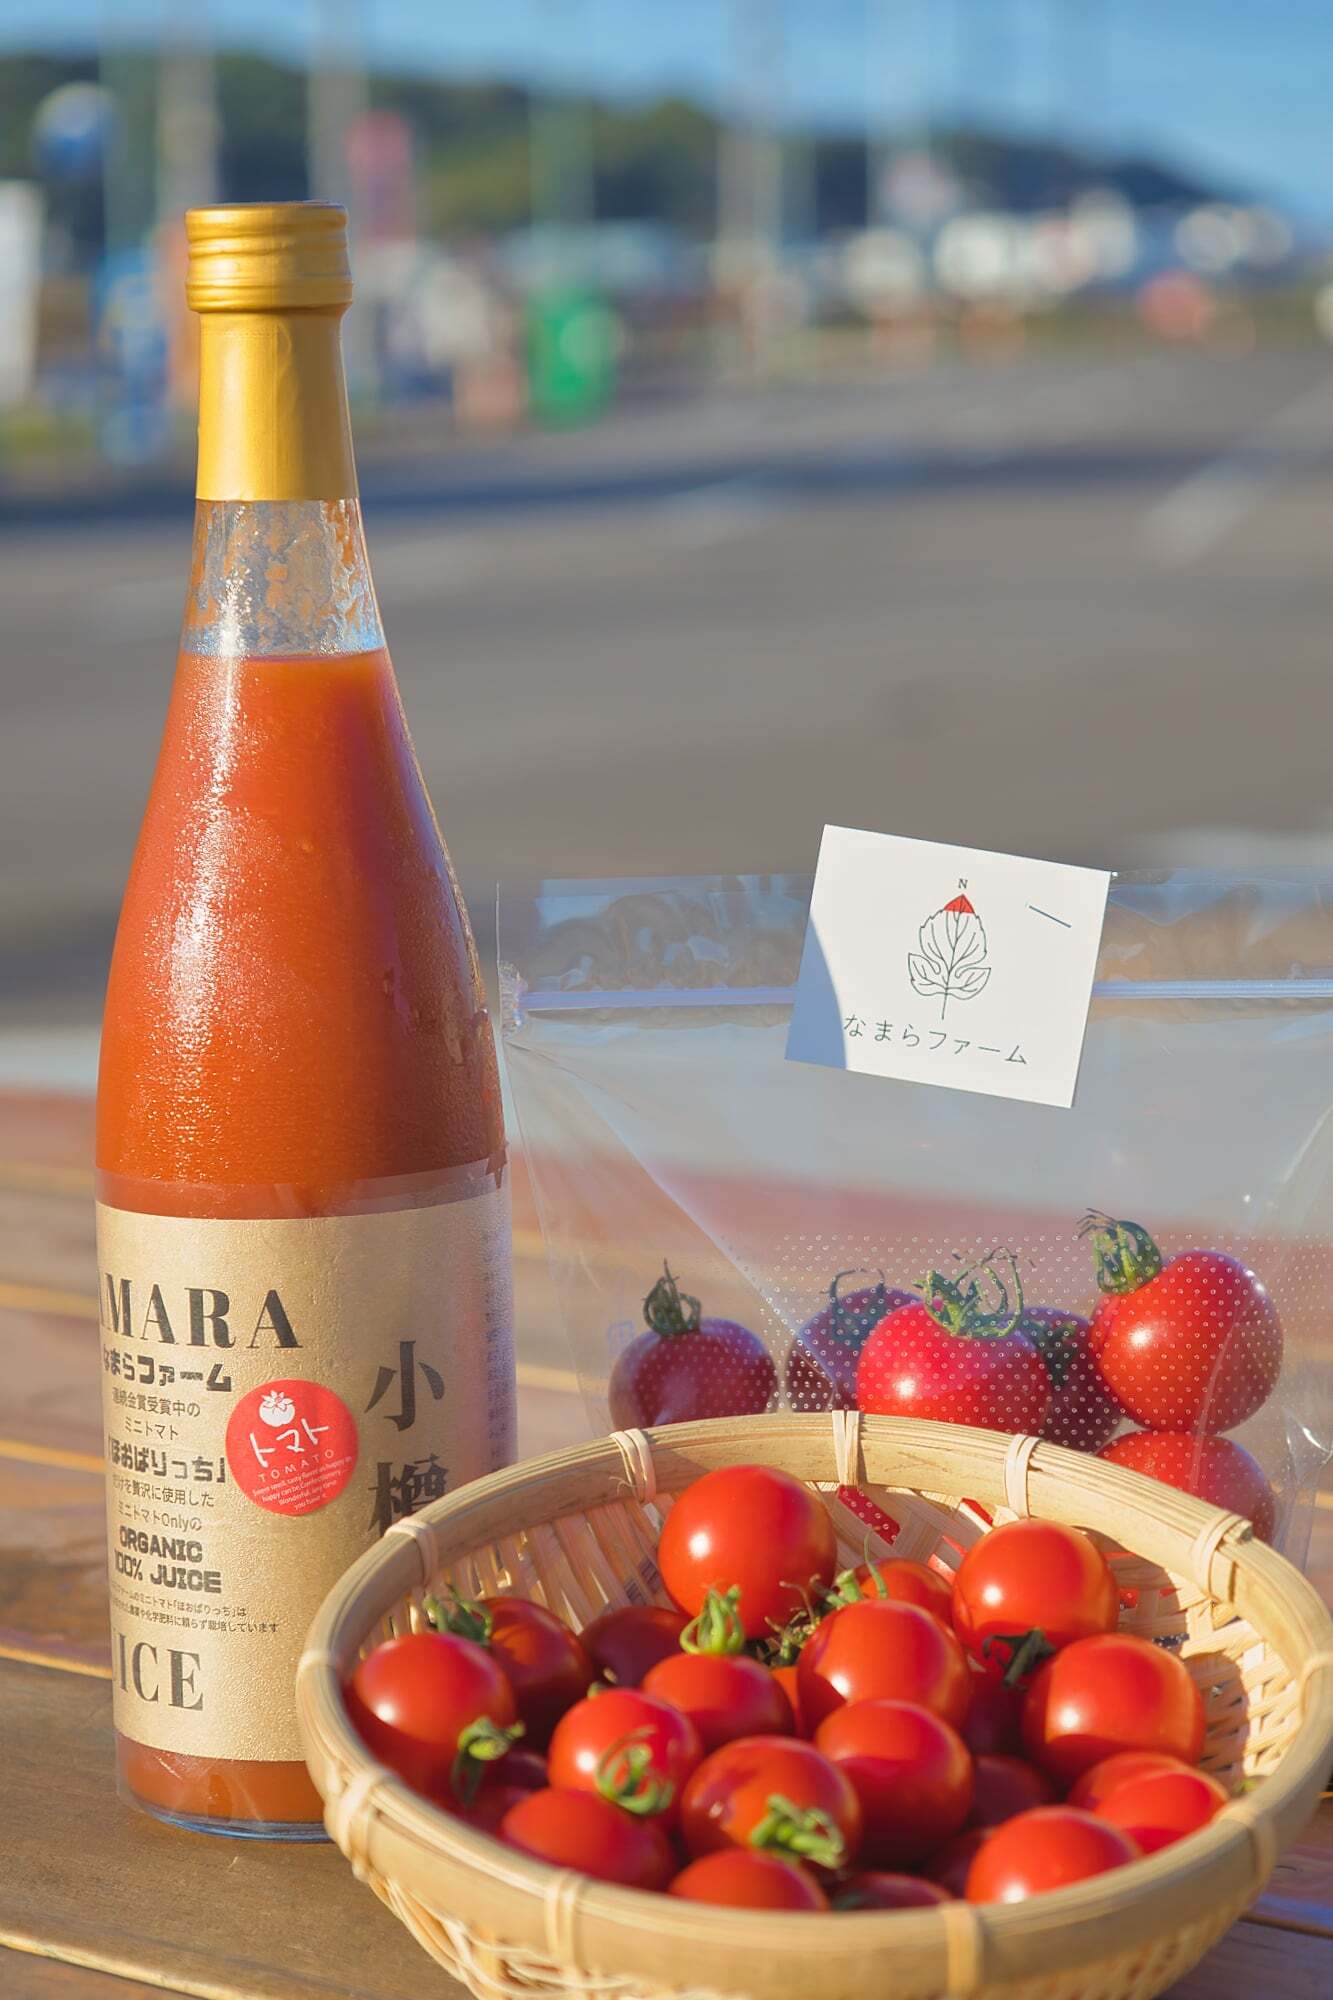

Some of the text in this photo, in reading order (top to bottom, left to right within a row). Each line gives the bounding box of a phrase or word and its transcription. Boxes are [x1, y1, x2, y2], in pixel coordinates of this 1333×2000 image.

[958, 878, 969, 890] N
[843, 1014, 1027, 1065] なまらファーム
[102, 1272, 304, 1349] MARA
[124, 1416, 179, 1441] ミニトマト
[249, 1417, 331, 1469] トマト
[258, 1448, 334, 1483] TOMATO
[120, 1525, 203, 1563] ORGANIC
[150, 1564, 222, 1594] JUICE
[113, 1628, 204, 1712] ICE
